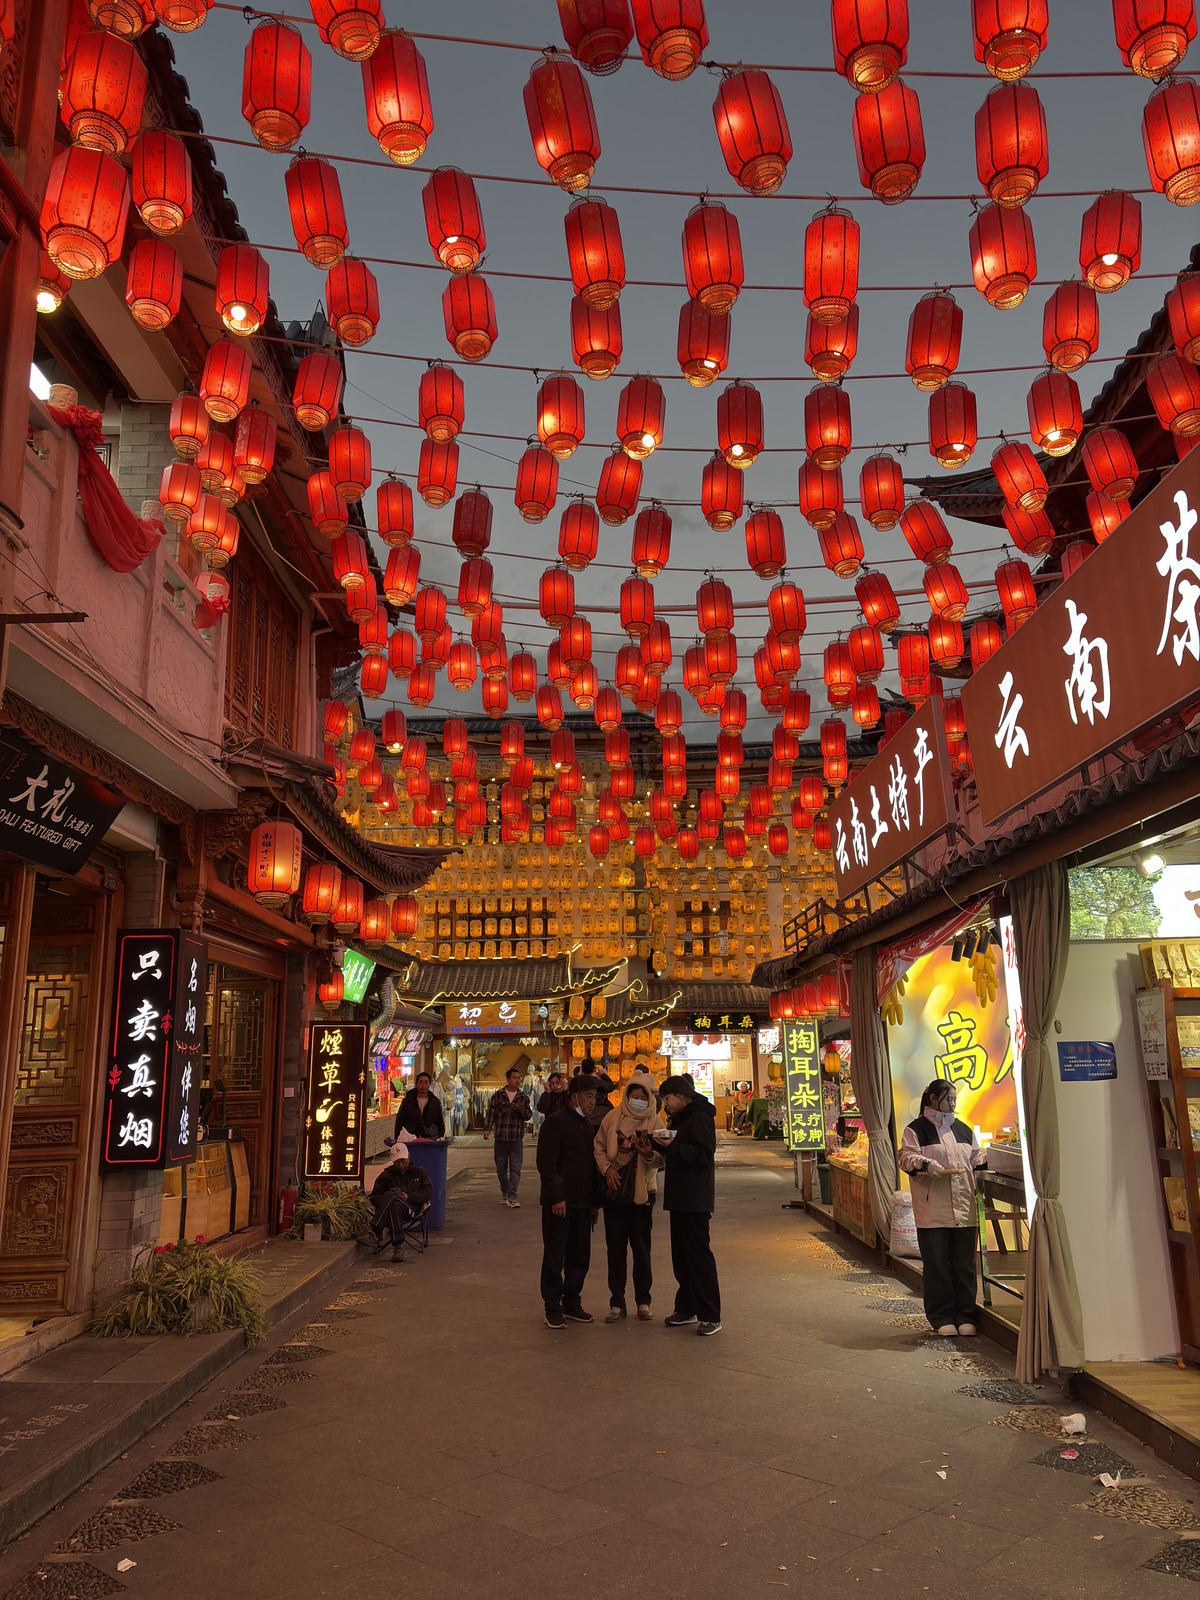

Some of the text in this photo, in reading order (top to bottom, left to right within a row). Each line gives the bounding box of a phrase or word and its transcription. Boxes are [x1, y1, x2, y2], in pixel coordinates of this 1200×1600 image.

[8, 764, 76, 823] 大礼
[835, 727, 934, 875] 云南土特产
[0, 808, 83, 852] DALI FEATURED GIFT
[458, 1002, 517, 1020] 初色
[694, 1014, 755, 1029] 掏耳朵
[117, 950, 163, 1149] 只卖真烟
[788, 1028, 820, 1108] 掏耳朵
[317, 1029, 343, 1174] 煙草 体验店
[791, 1112, 822, 1127] 足疗
[344, 1093, 356, 1171] 只卖真烟 假一赔十
[792, 1128, 823, 1143] 修脚
